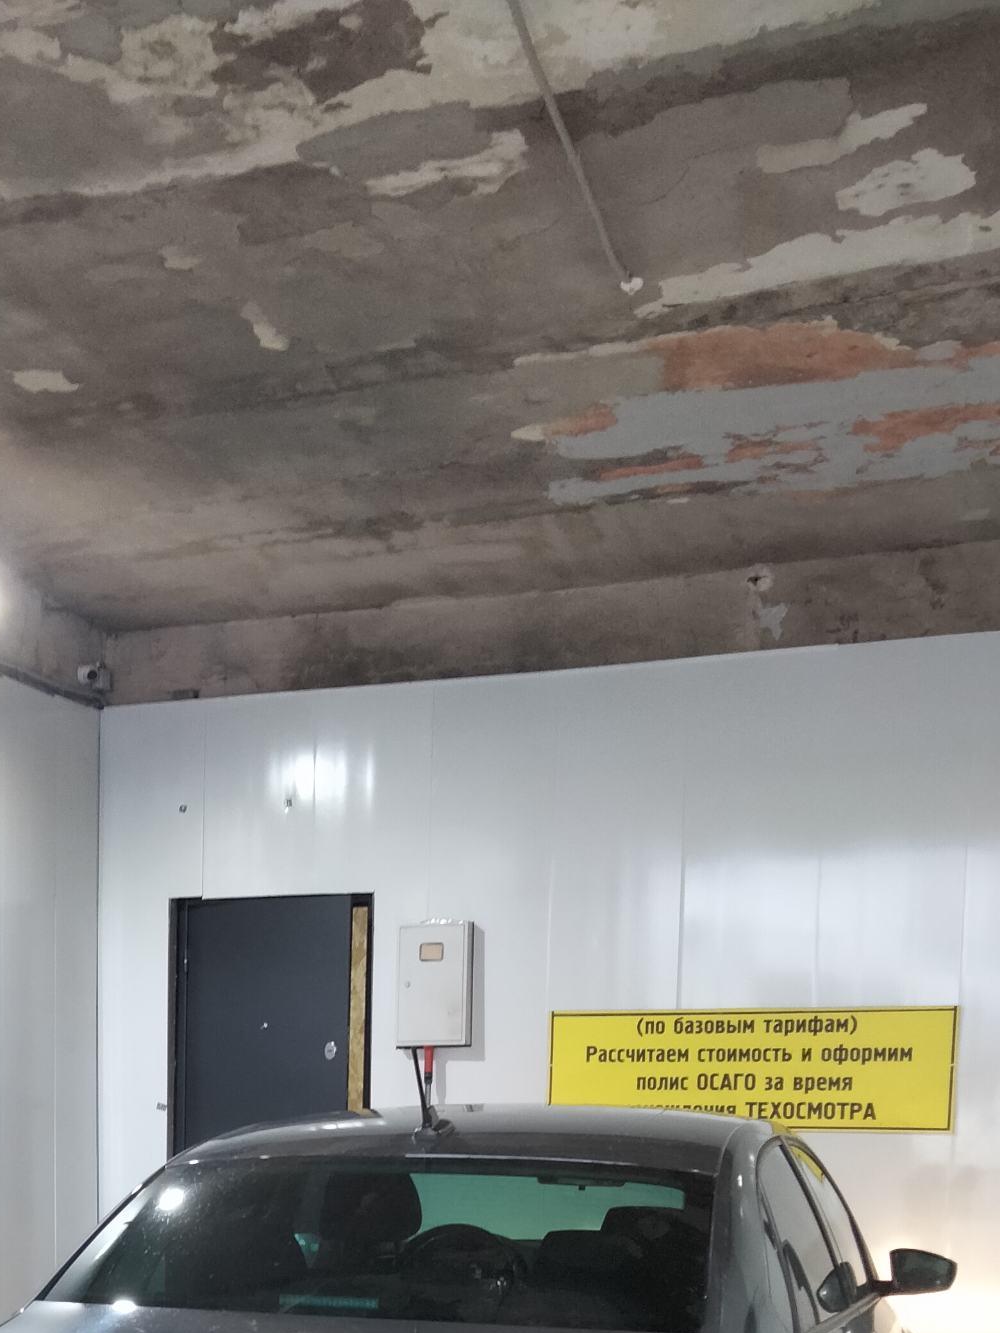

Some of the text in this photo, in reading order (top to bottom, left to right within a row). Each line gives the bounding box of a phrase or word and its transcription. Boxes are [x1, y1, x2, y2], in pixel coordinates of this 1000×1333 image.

[636, 1015, 859, 1037] (по базовым тарифам)
[585, 1044, 913, 1065] Рассчитаем стоимость и оформим
[636, 1073, 854, 1094] полис ОСАГО за время
[745, 1101, 877, 1120] ТЕХОСМОТРА
